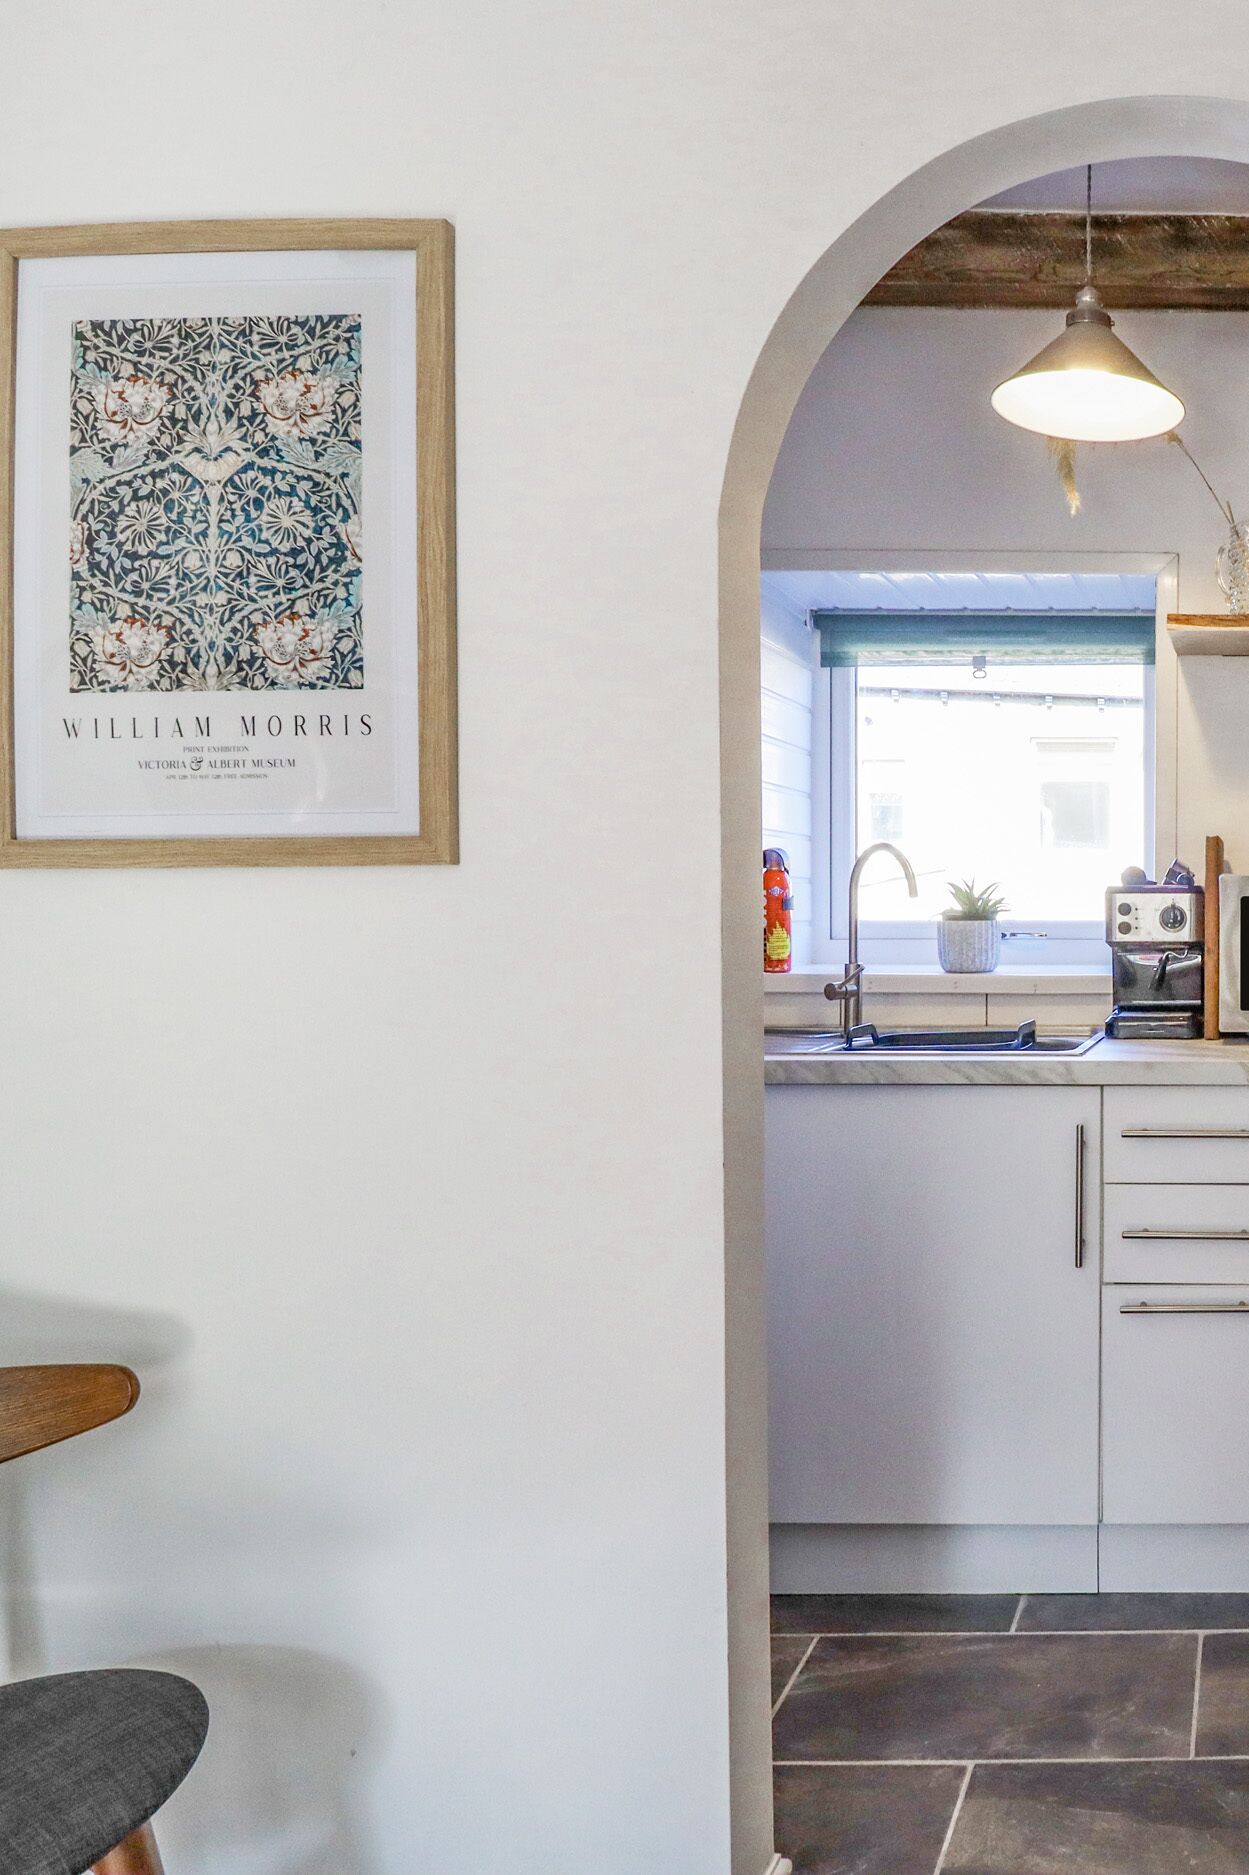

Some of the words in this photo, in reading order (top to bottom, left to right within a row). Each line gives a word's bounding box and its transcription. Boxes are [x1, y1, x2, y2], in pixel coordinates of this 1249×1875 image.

[62, 715, 211, 739] WILLIAM
[241, 713, 372, 737] MORRIS
[183, 745, 204, 753] PRINT
[207, 745, 250, 753] EXHIBITION
[138, 759, 187, 770] VICTORIA
[190, 755, 203, 772] &
[207, 758, 248, 769] ALBERT
[251, 758, 296, 769] MUSEUM
